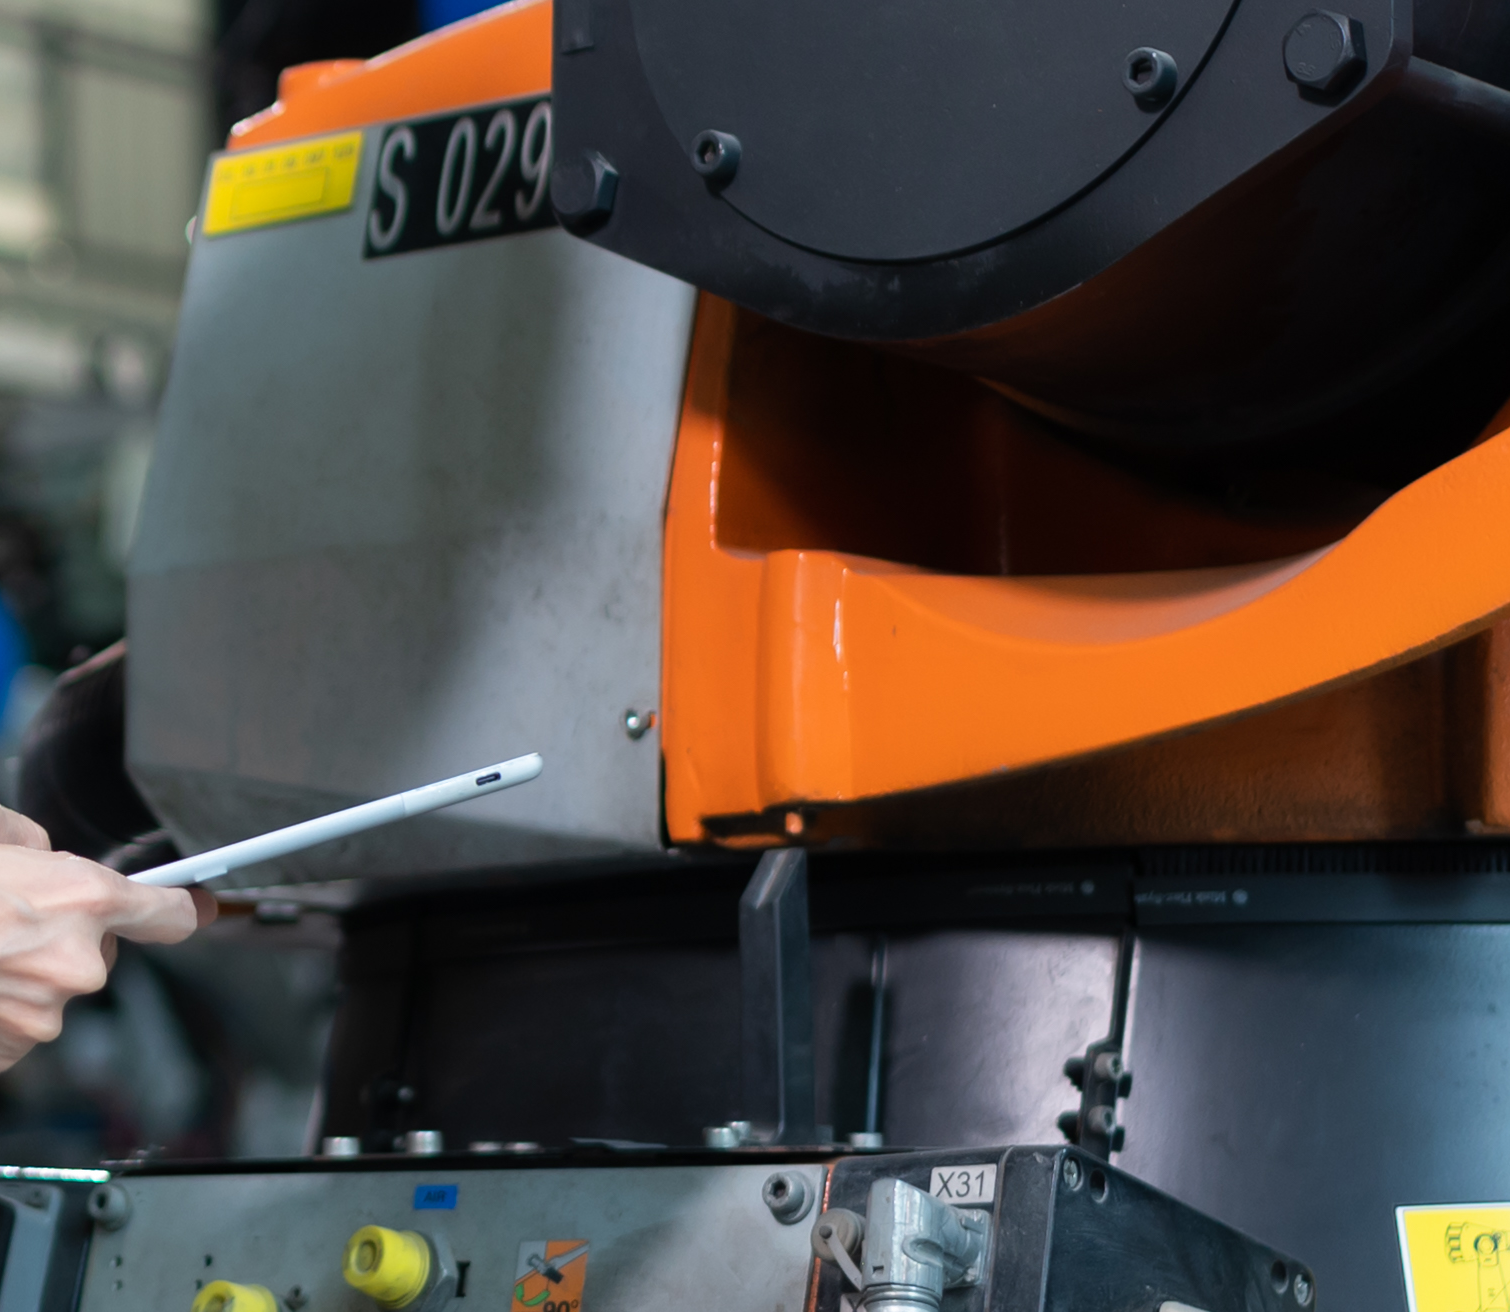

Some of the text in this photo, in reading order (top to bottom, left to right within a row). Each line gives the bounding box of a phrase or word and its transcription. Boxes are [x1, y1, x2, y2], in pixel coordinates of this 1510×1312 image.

[369, 125, 416, 251] S
[424, 1190, 447, 1203] AIR
[935, 1170, 985, 1199] X31
